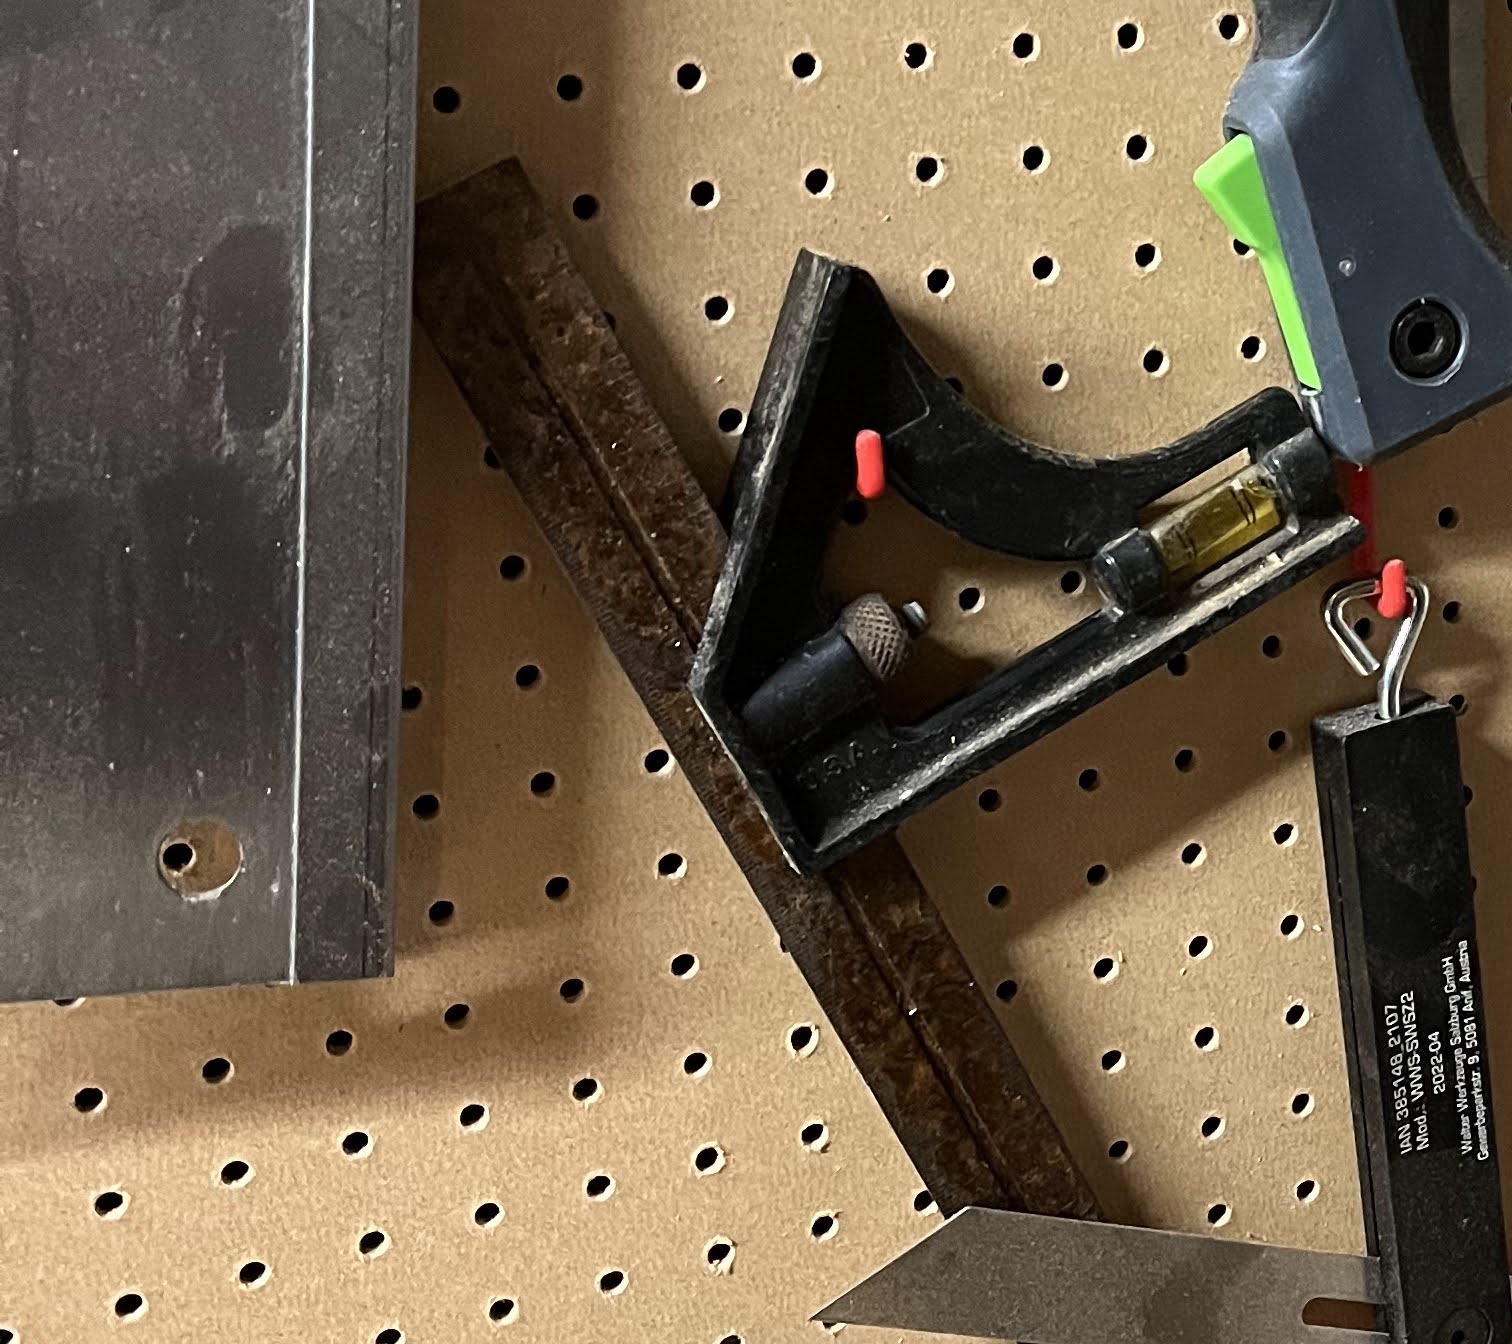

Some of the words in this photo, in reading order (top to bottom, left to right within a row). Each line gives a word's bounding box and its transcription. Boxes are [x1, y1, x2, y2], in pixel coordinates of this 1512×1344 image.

[1442, 956, 1456, 994] GmbH
[1464, 1016, 1478, 1049] 5081
[1385, 1005, 1409, 1121] 385148_2107
[1428, 1031, 1446, 1095] 2022-04
[1398, 1123, 1412, 1154] IAN
